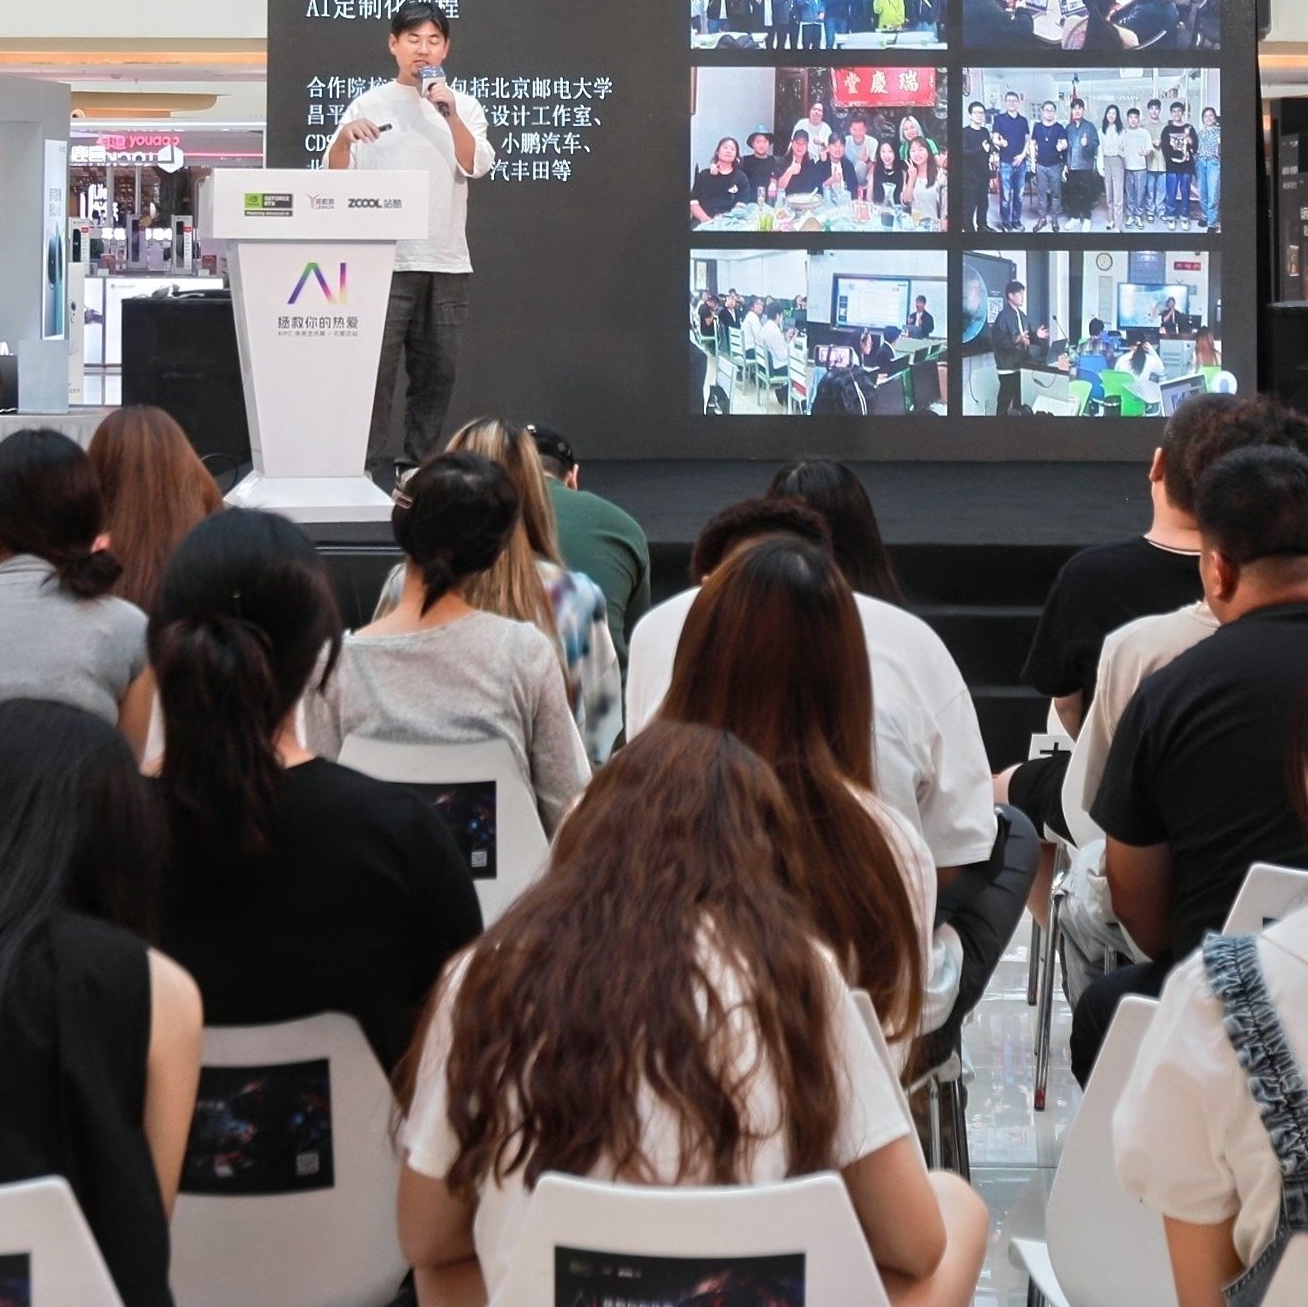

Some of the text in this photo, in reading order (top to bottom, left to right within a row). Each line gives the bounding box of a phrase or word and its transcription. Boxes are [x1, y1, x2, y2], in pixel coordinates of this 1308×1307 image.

[348, 198, 382, 208] ZCOOL
[287, 262, 347, 305] AI
[277, 316, 359, 330] 拯救你的热爱
